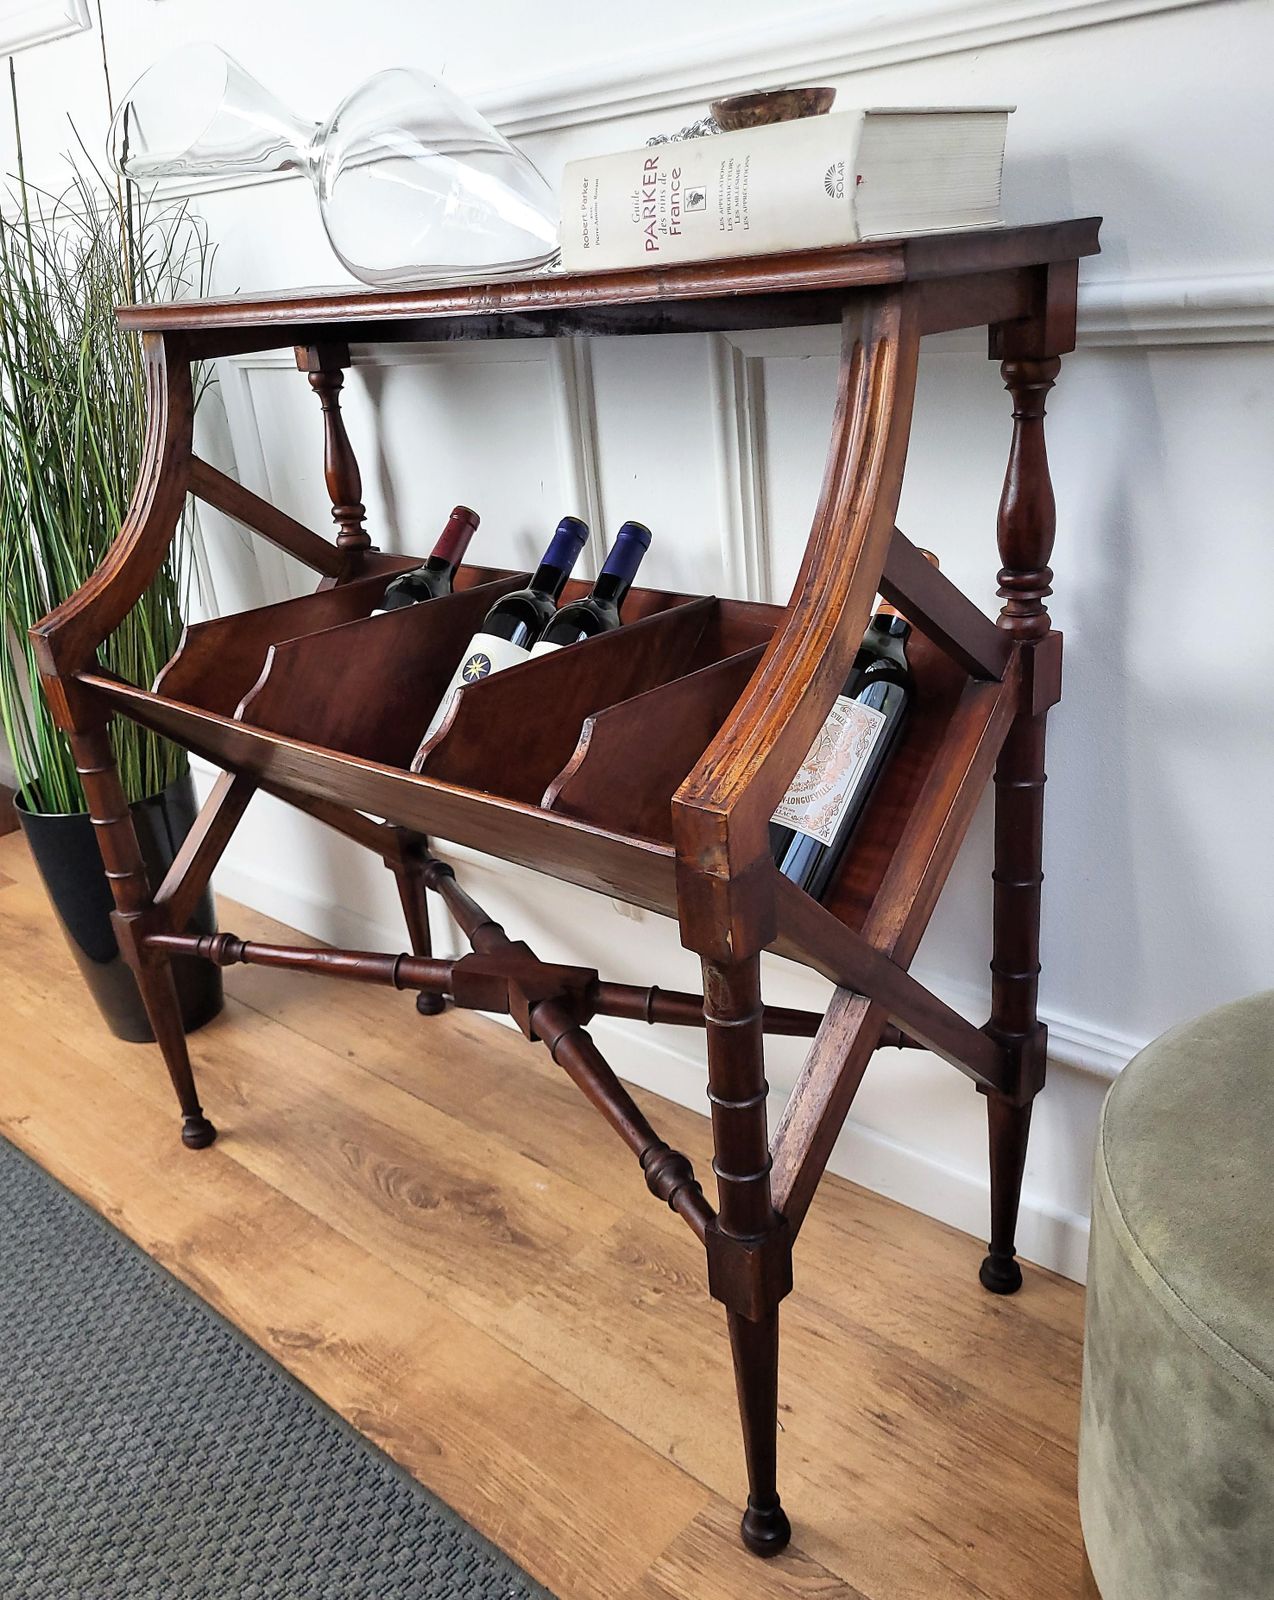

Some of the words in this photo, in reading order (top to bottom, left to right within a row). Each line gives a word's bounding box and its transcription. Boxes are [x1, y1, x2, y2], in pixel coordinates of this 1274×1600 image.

[581, 177, 589, 211] Parker
[657, 172, 668, 185] de
[836, 161, 845, 199] SOLAR
[631, 190, 640, 223] Guide
[642, 156, 660, 252] PARKER
[658, 189, 667, 213] vins
[669, 167, 682, 236] France
[581, 214, 590, 249] Robert
[658, 217, 668, 235] des
